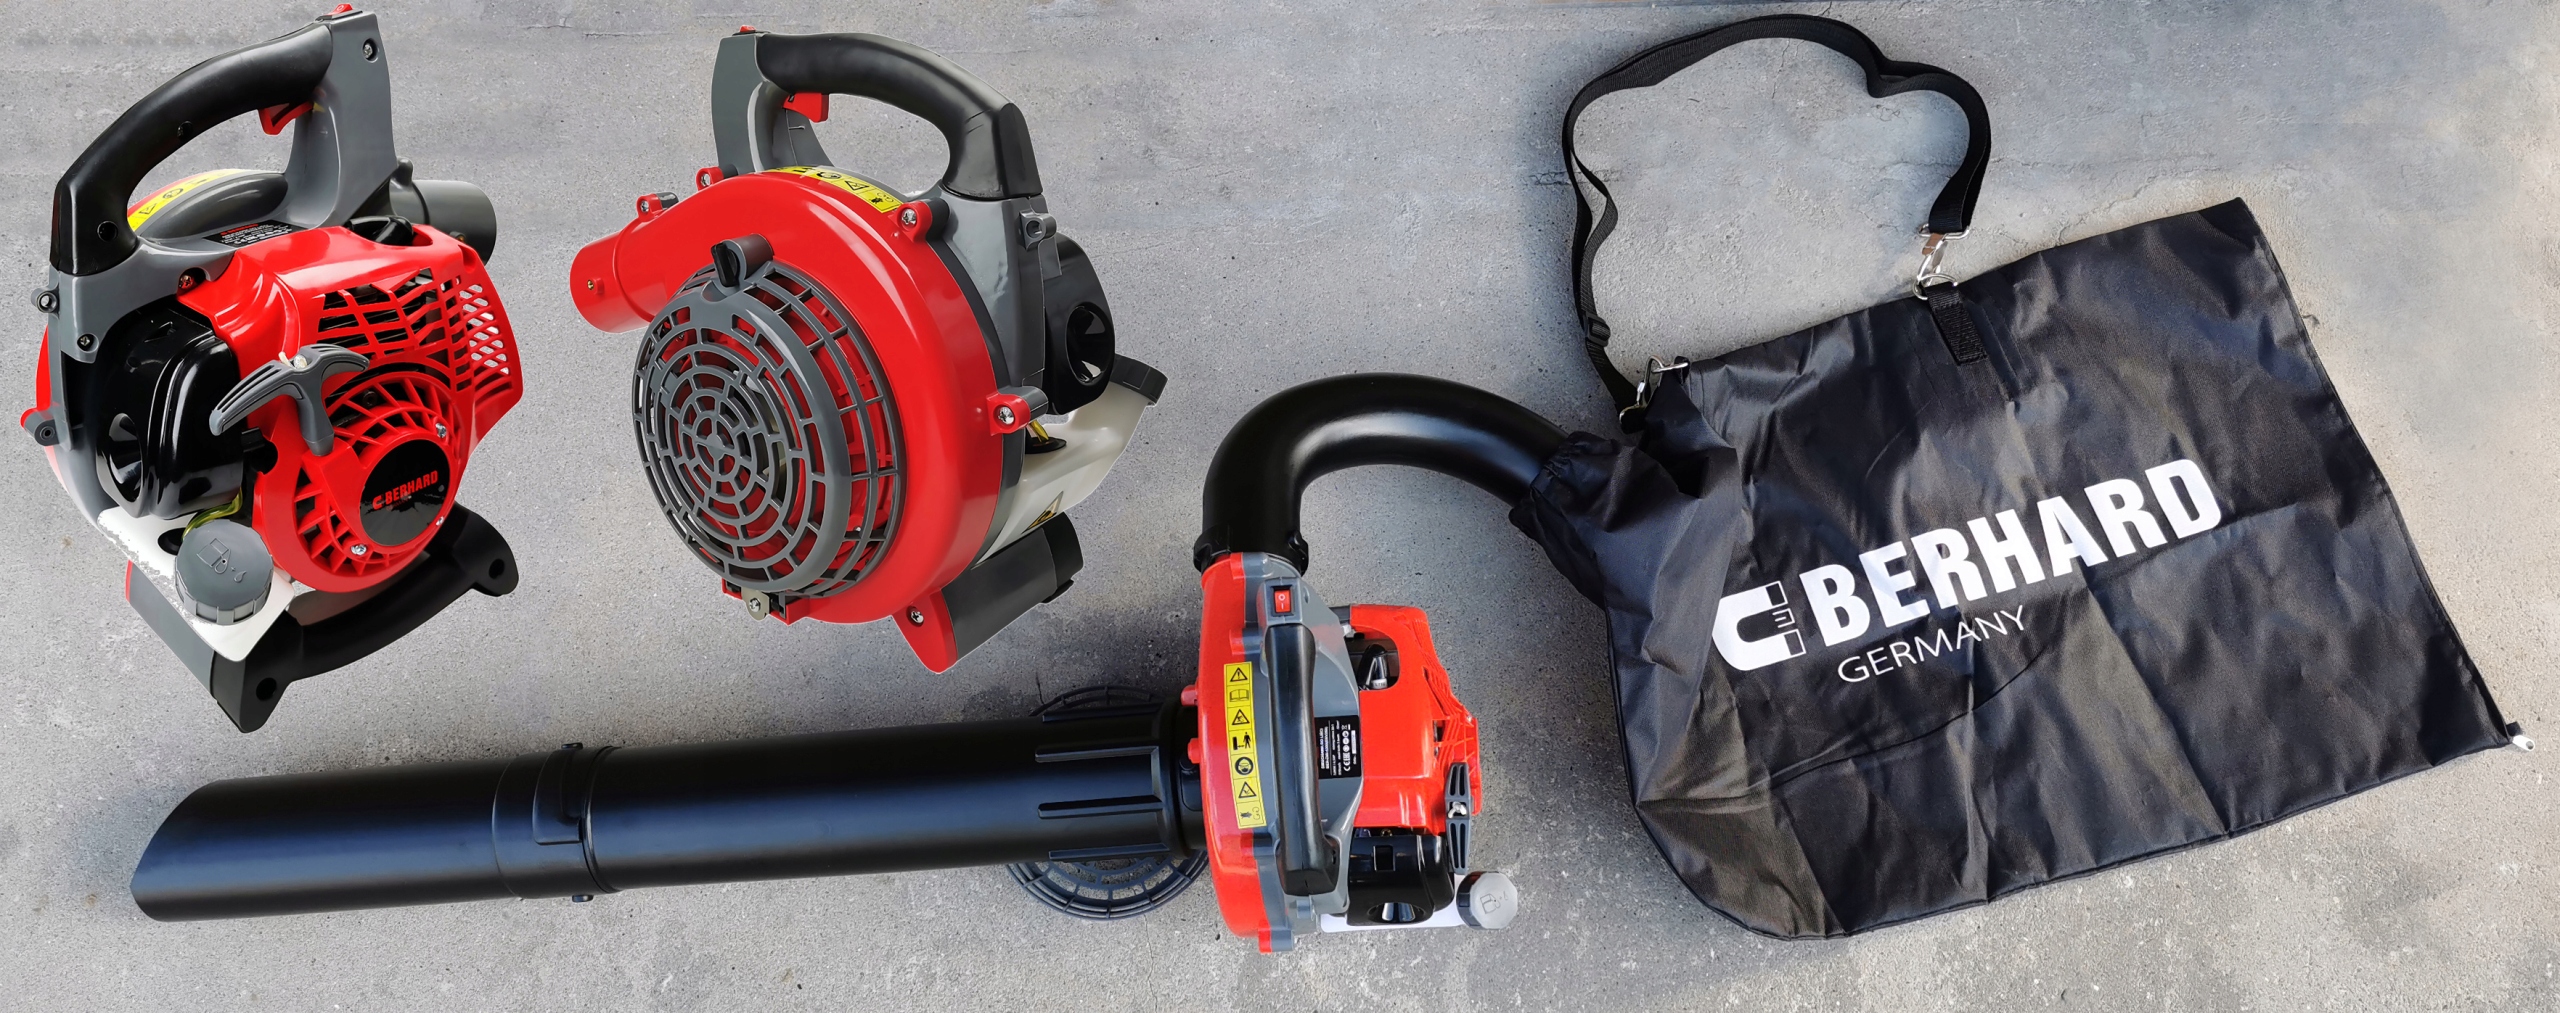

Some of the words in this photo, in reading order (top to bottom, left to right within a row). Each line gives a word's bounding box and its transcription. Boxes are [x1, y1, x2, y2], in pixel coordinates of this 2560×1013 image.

[385, 470, 439, 505] BERHARD
[1800, 458, 2222, 647] BERHARD
[1837, 604, 2025, 683] GERMANY
